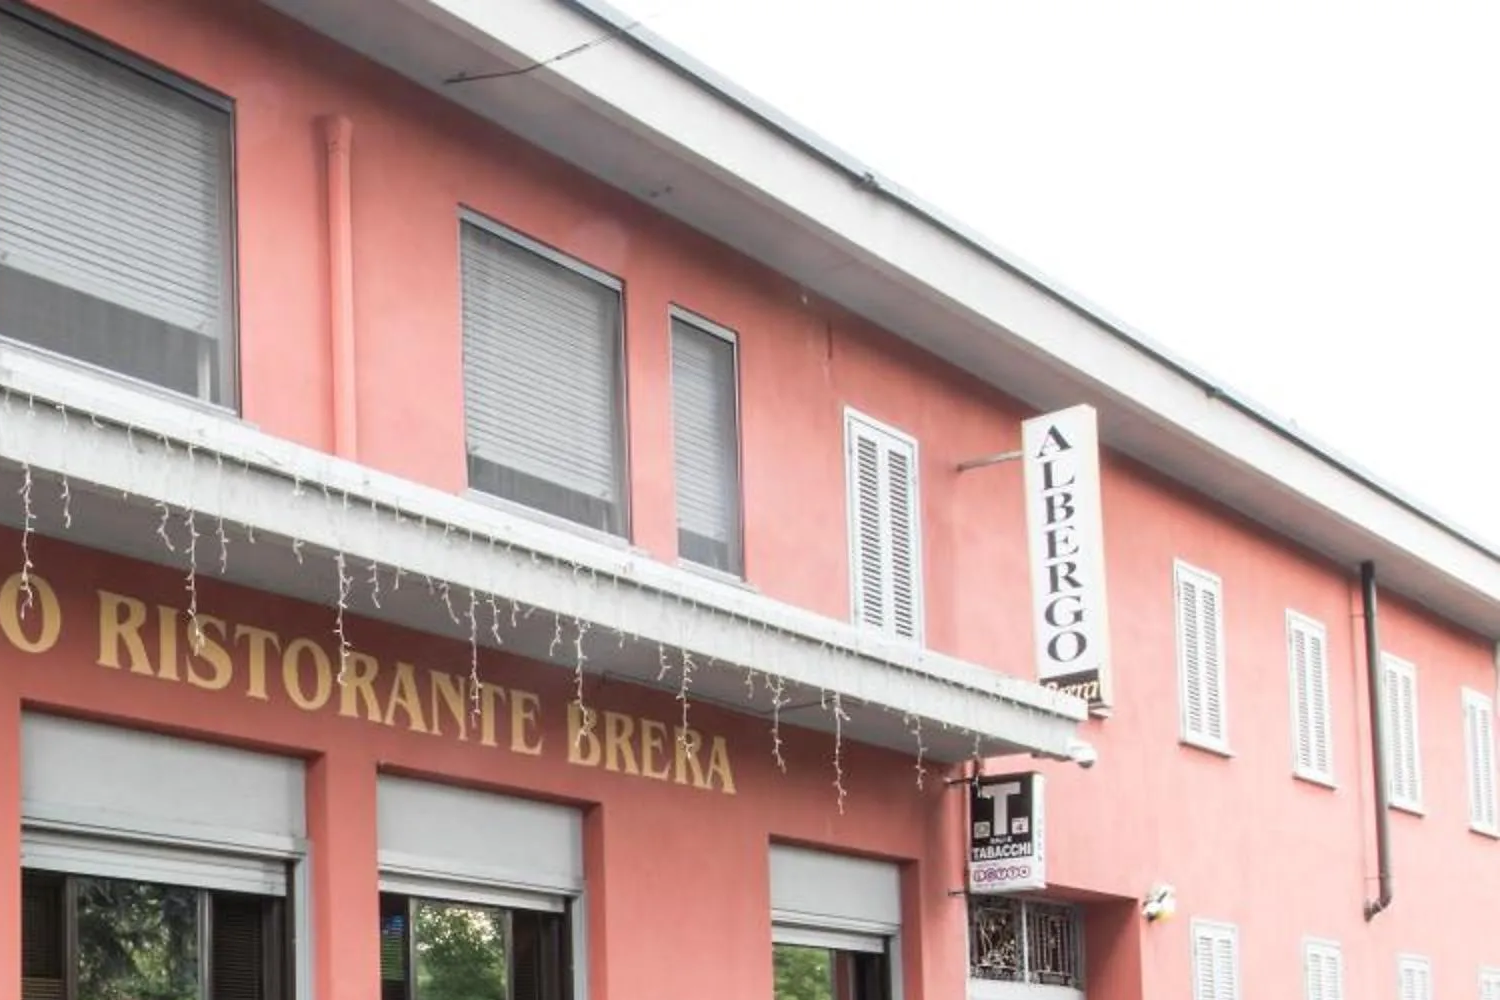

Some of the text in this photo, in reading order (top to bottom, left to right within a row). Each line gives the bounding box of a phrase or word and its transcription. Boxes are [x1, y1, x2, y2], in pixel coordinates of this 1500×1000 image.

[1035, 424, 1088, 663] ALBERGO
[96, 589, 542, 756] RISTORANTE
[566, 700, 737, 795] BRERA
[972, 842, 1032, 860] TABACCHI
[980, 781, 1020, 836] T
